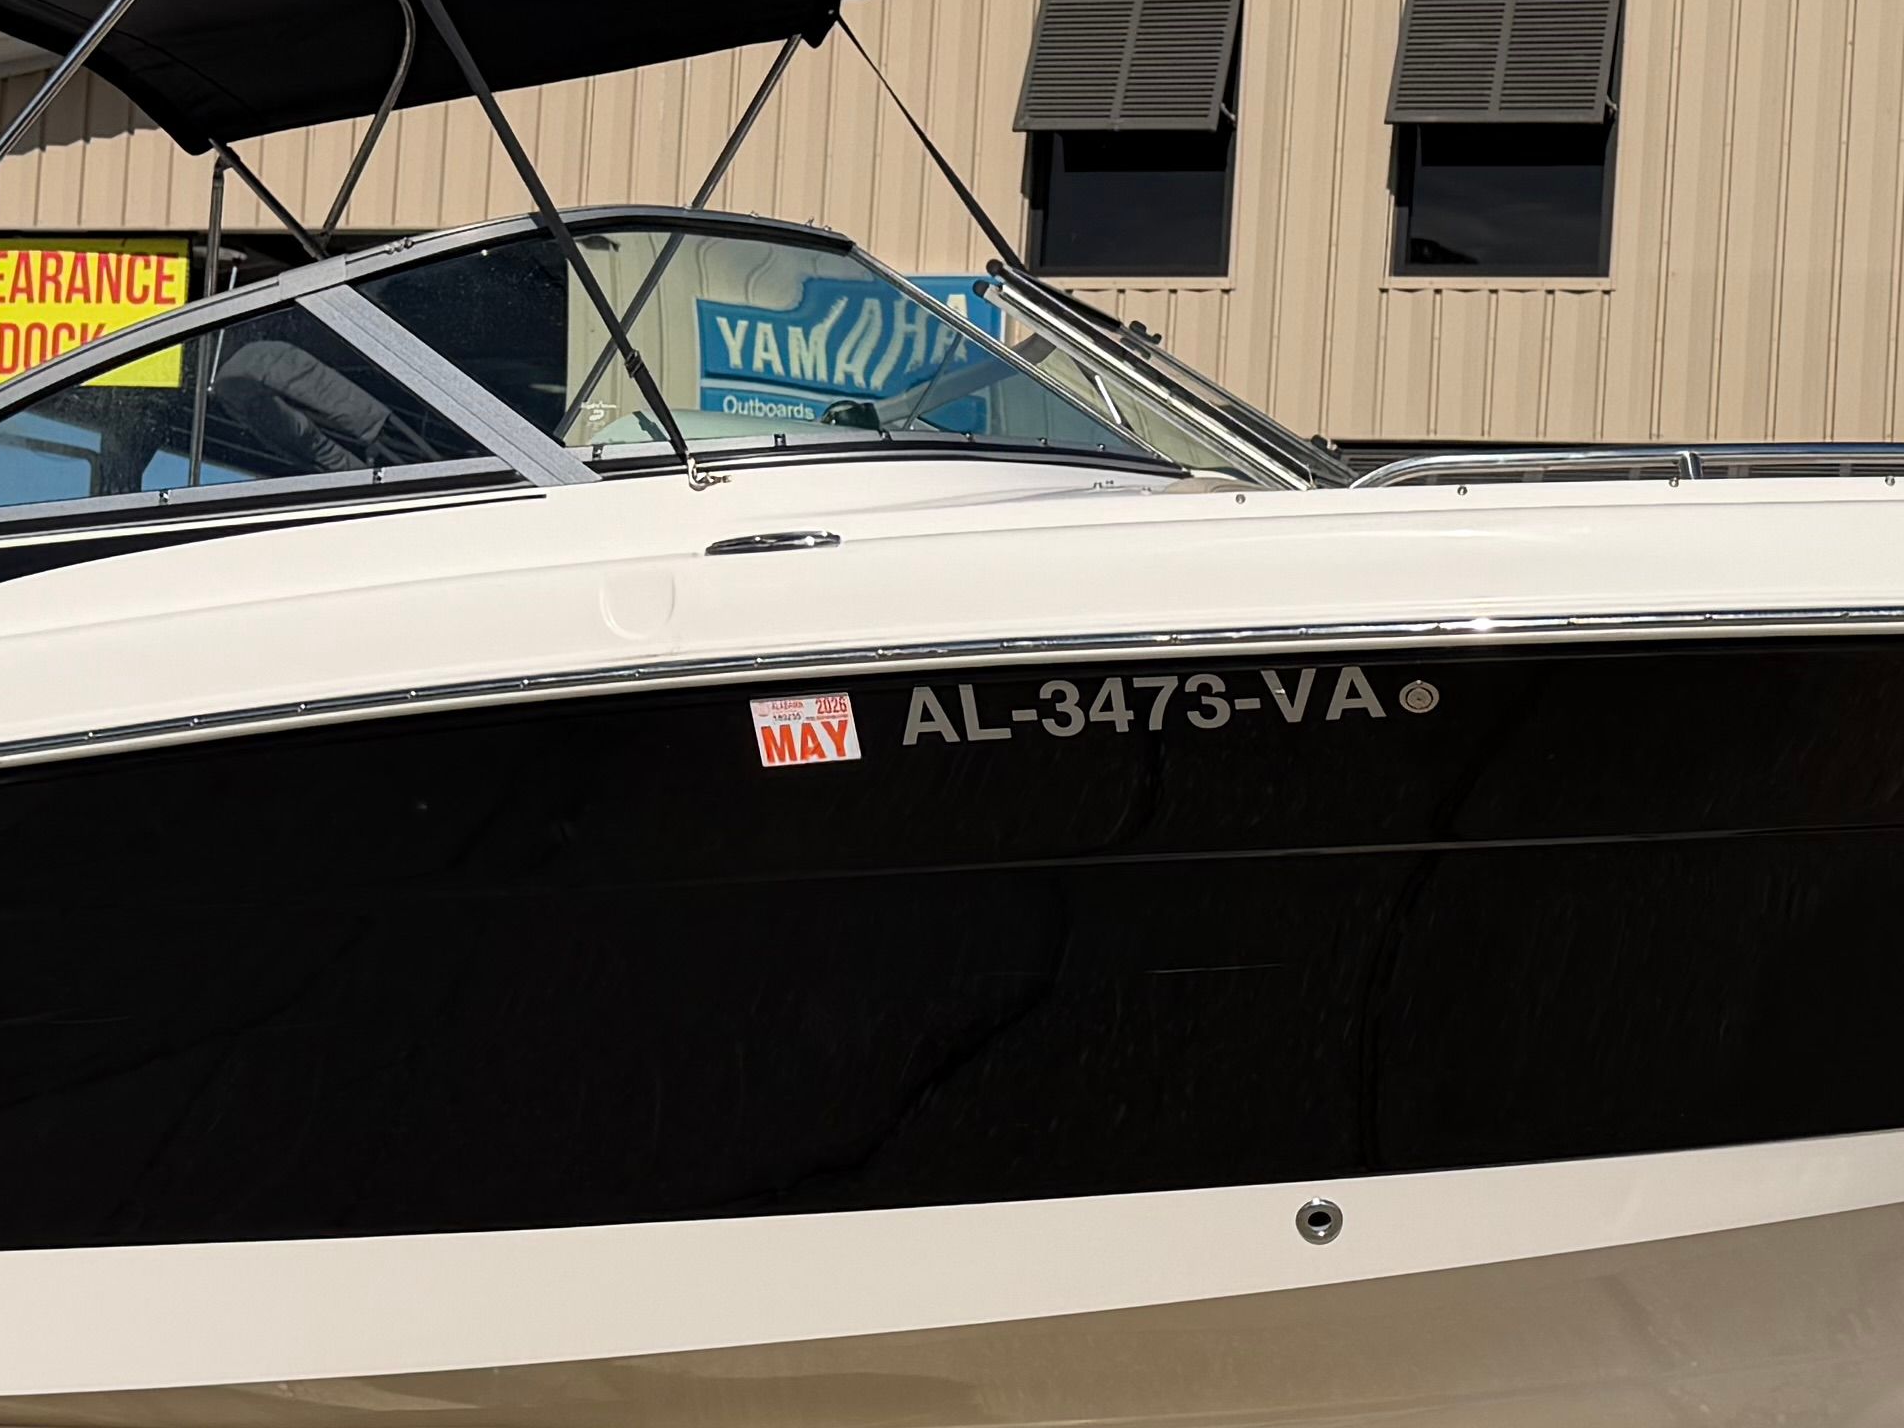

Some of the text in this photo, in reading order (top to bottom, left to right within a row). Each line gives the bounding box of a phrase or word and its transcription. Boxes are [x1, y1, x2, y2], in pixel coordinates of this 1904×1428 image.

[715, 293, 969, 392] YAMAHA
[722, 394, 815, 421] Outboards
[816, 696, 848, 715] 2026
[902, 666, 1387, 746] AL-3473-VA
[761, 719, 848, 764] MAY
